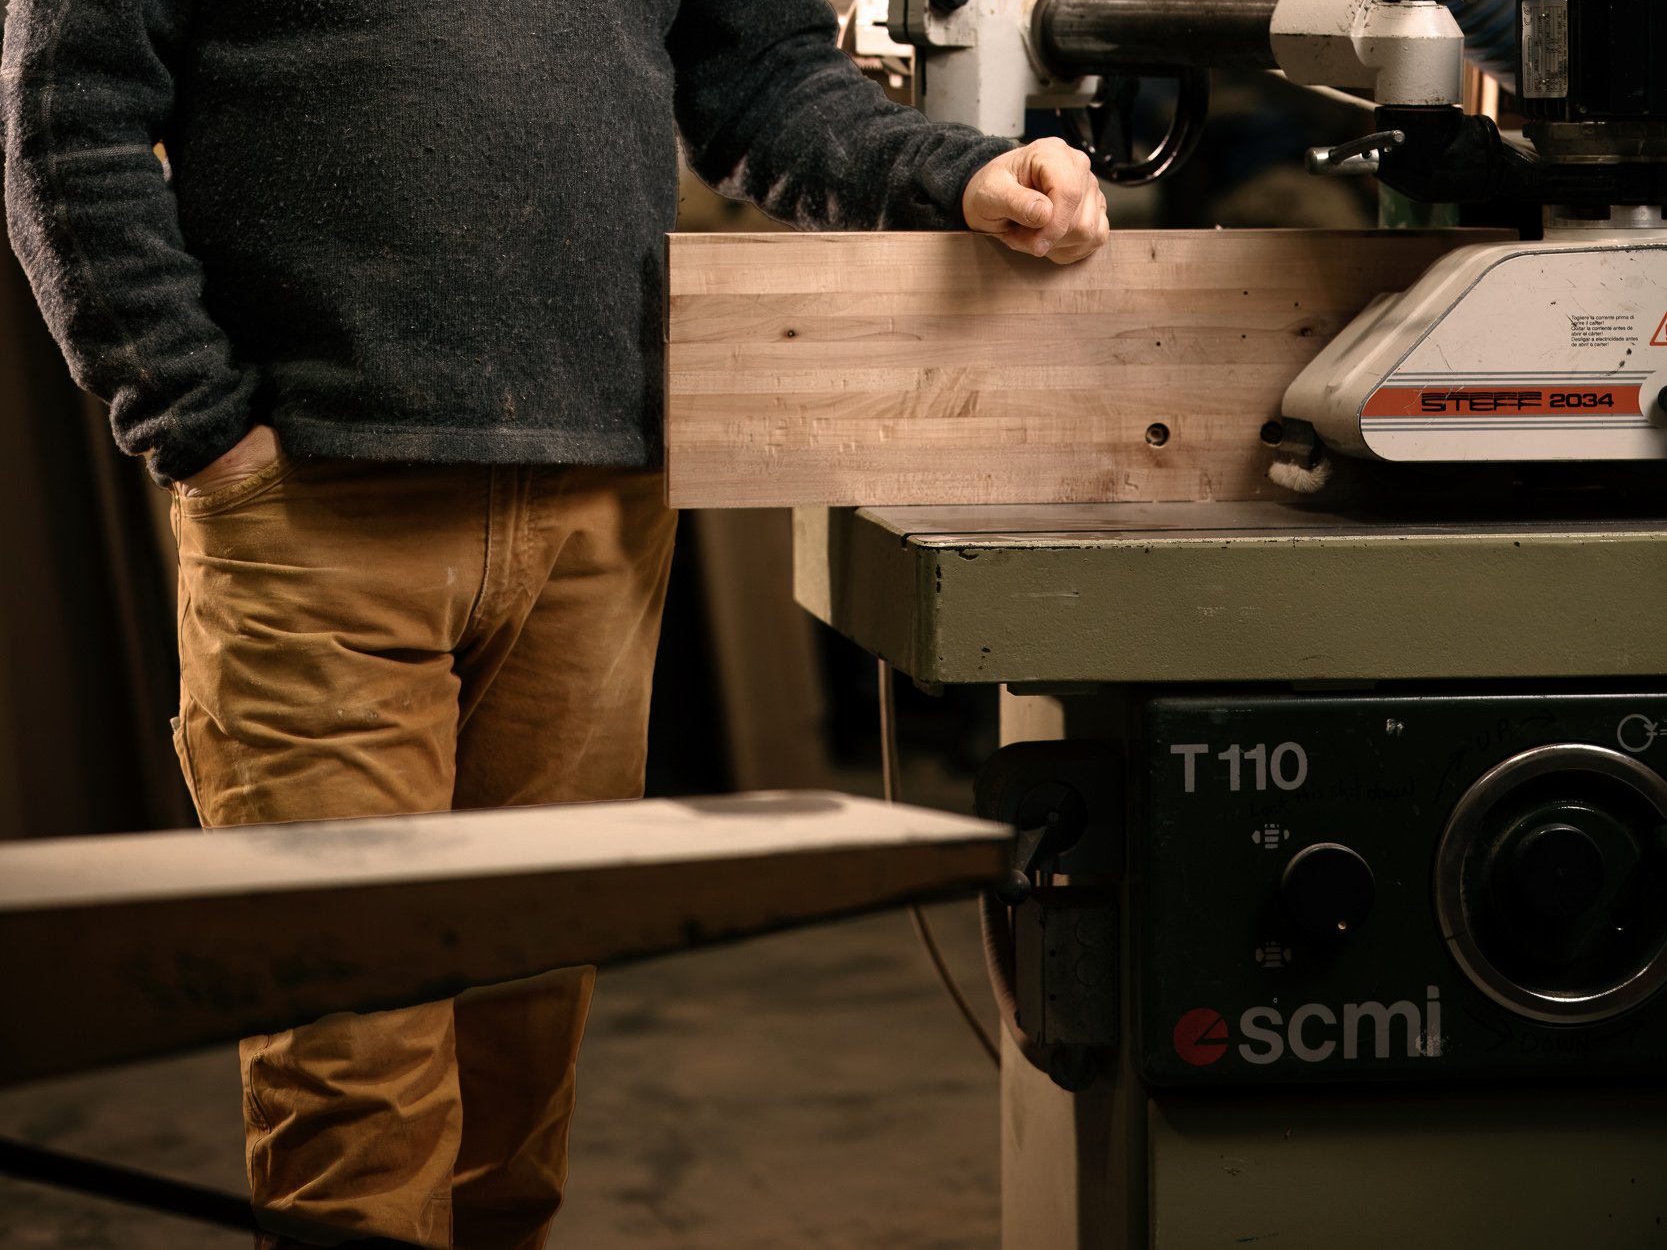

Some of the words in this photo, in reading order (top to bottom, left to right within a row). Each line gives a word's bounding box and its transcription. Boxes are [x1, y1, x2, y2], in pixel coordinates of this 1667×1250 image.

[1421, 391, 1543, 412] STEFF
[1549, 393, 1615, 409] 2034
[1476, 718, 1510, 752] UP
[1170, 743, 1209, 793] T
[1217, 741, 1308, 791] 110
[1237, 984, 1443, 1065] scmi
